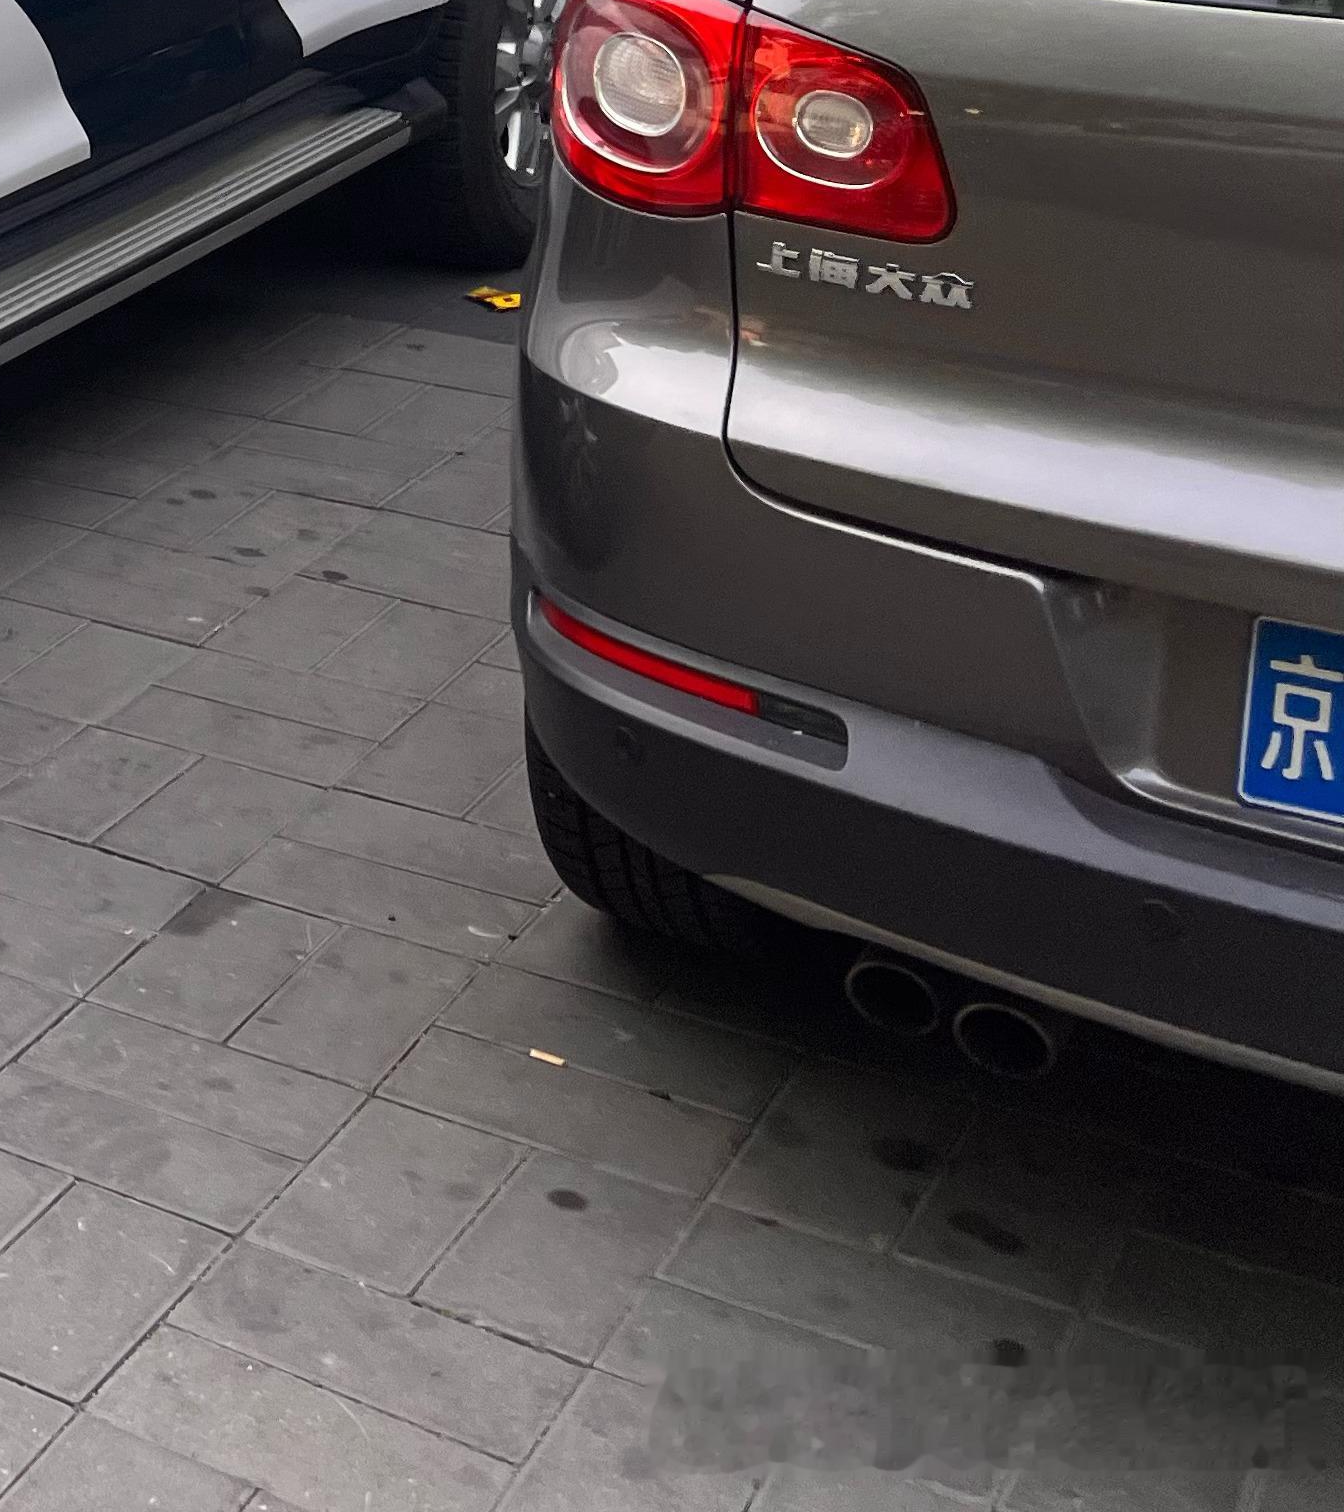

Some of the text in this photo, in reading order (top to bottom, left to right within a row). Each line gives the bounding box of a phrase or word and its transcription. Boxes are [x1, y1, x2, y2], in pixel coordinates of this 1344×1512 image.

[755, 240, 975, 310] 上海大众
[1260, 653, 1344, 782] 京
